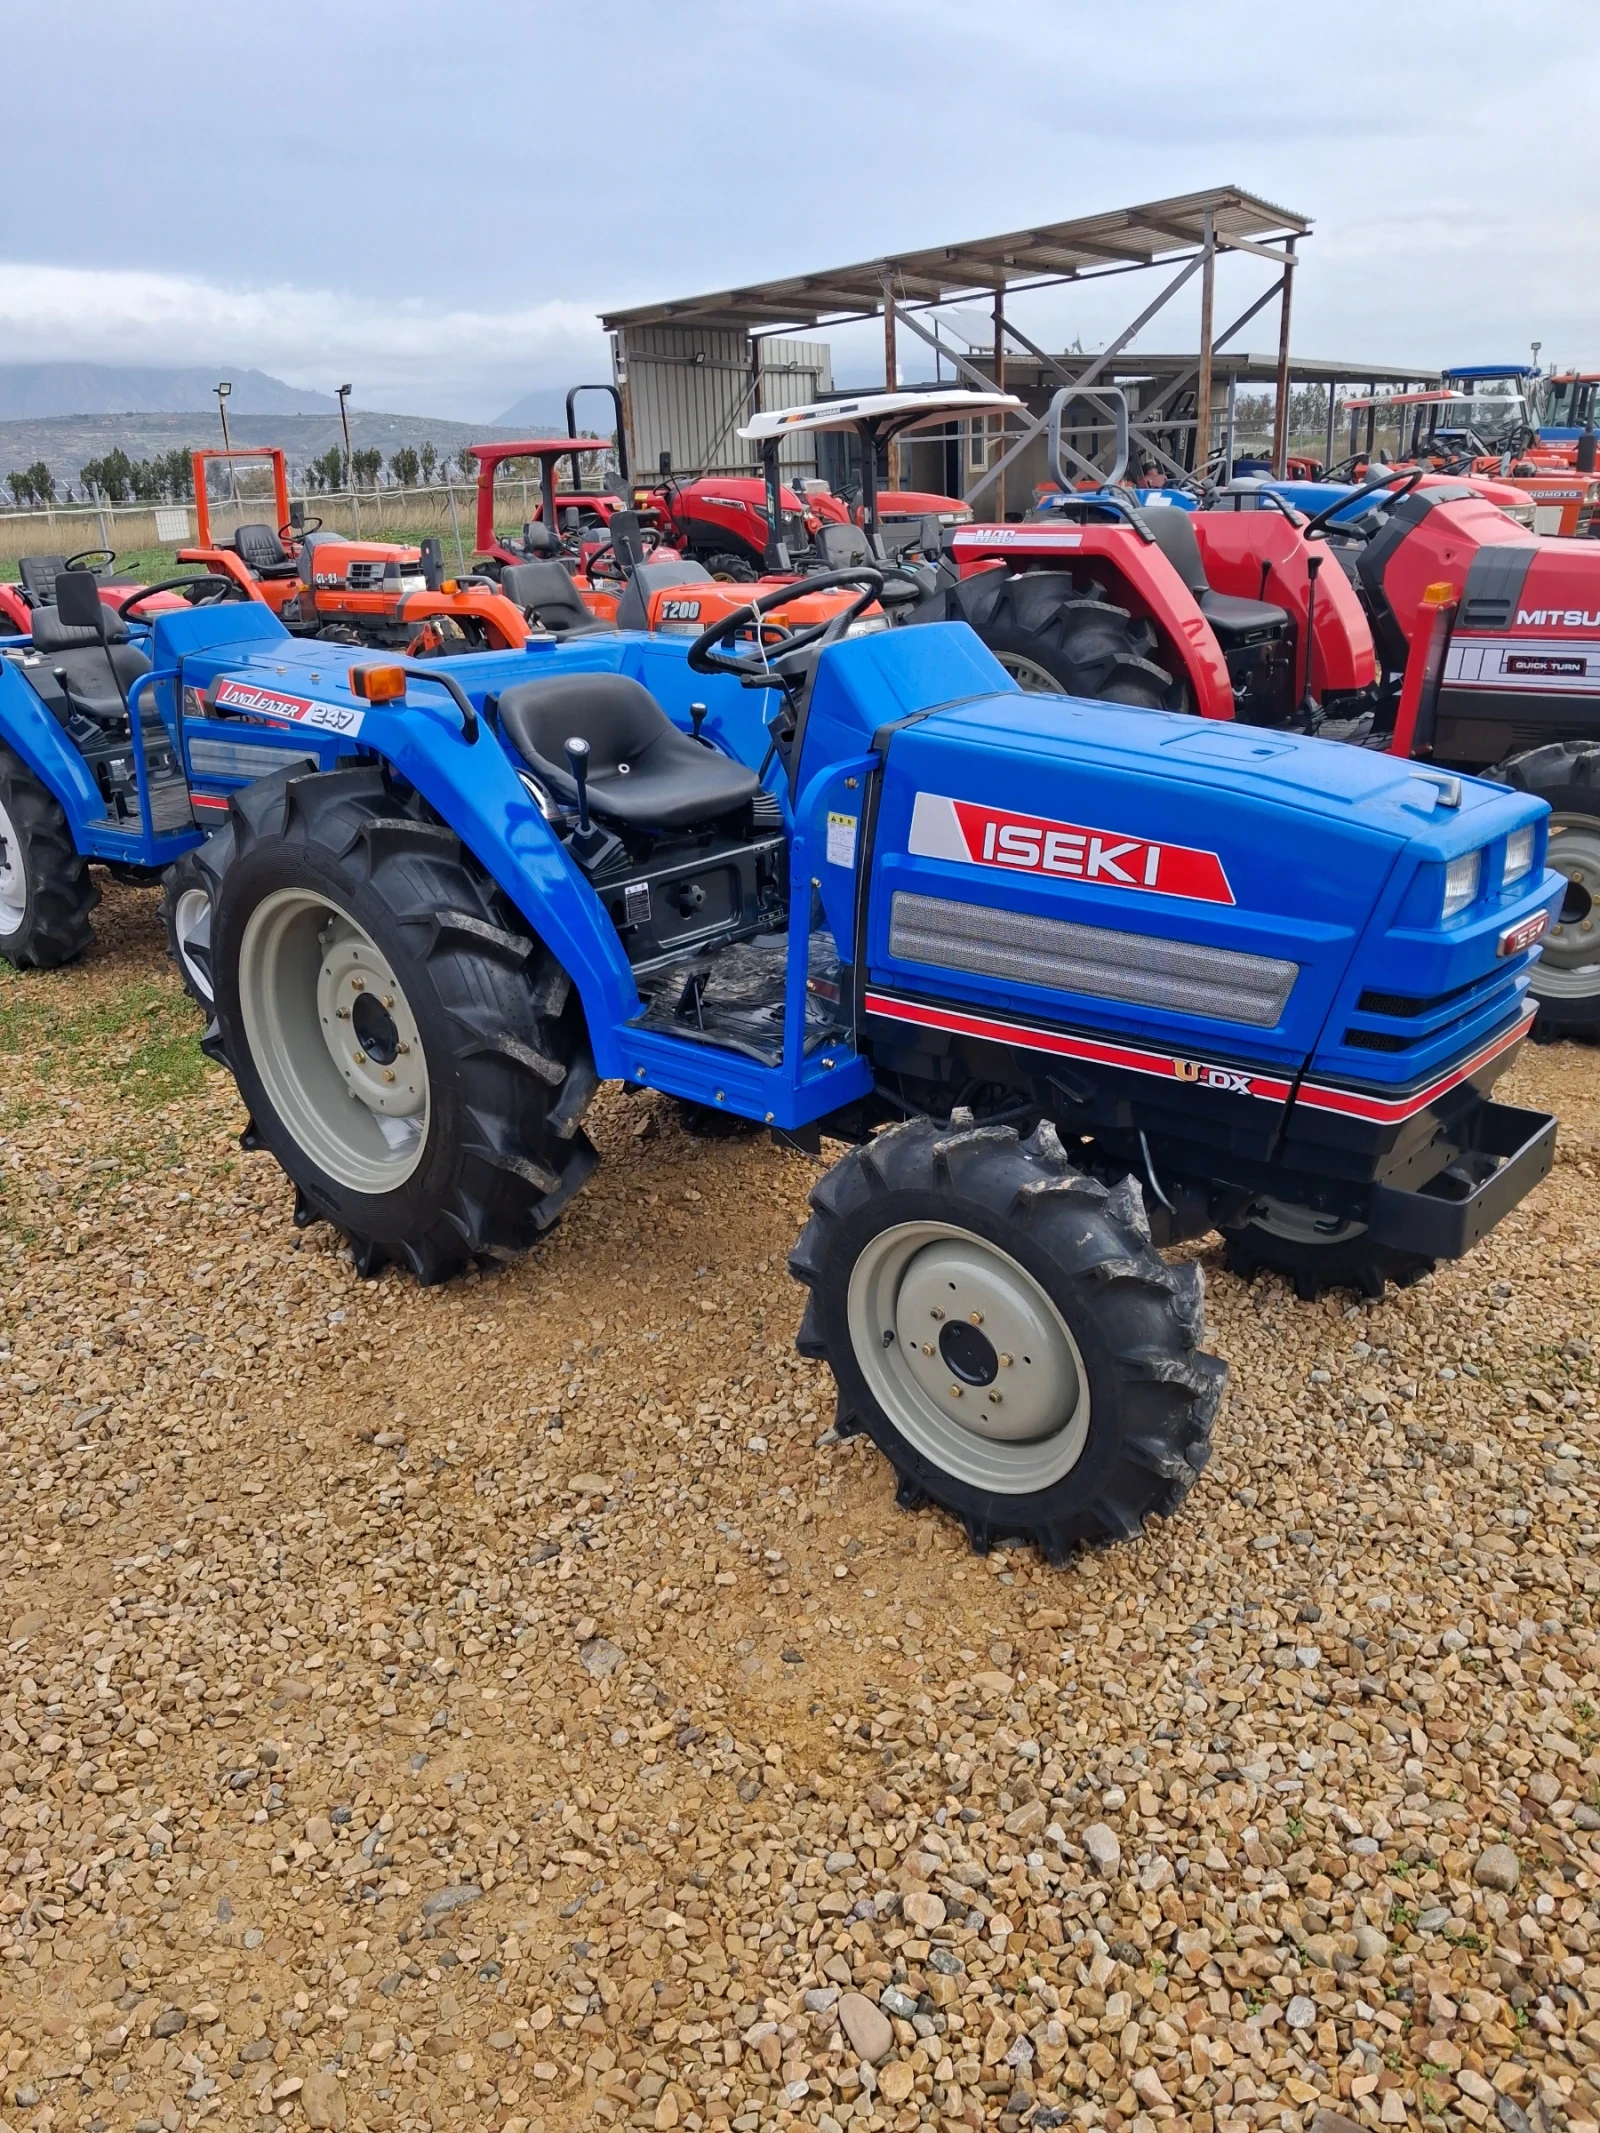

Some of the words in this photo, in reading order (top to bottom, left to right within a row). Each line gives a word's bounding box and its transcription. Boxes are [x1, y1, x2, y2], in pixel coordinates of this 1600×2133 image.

[661, 601, 701, 621] T200
[1515, 661, 1547, 669] QUICK
[1551, 663, 1581, 671] TURN
[310, 705, 354, 730] 247
[982, 822, 1161, 887] ISEKI
[1172, 1059, 1252, 1095] U-DX
